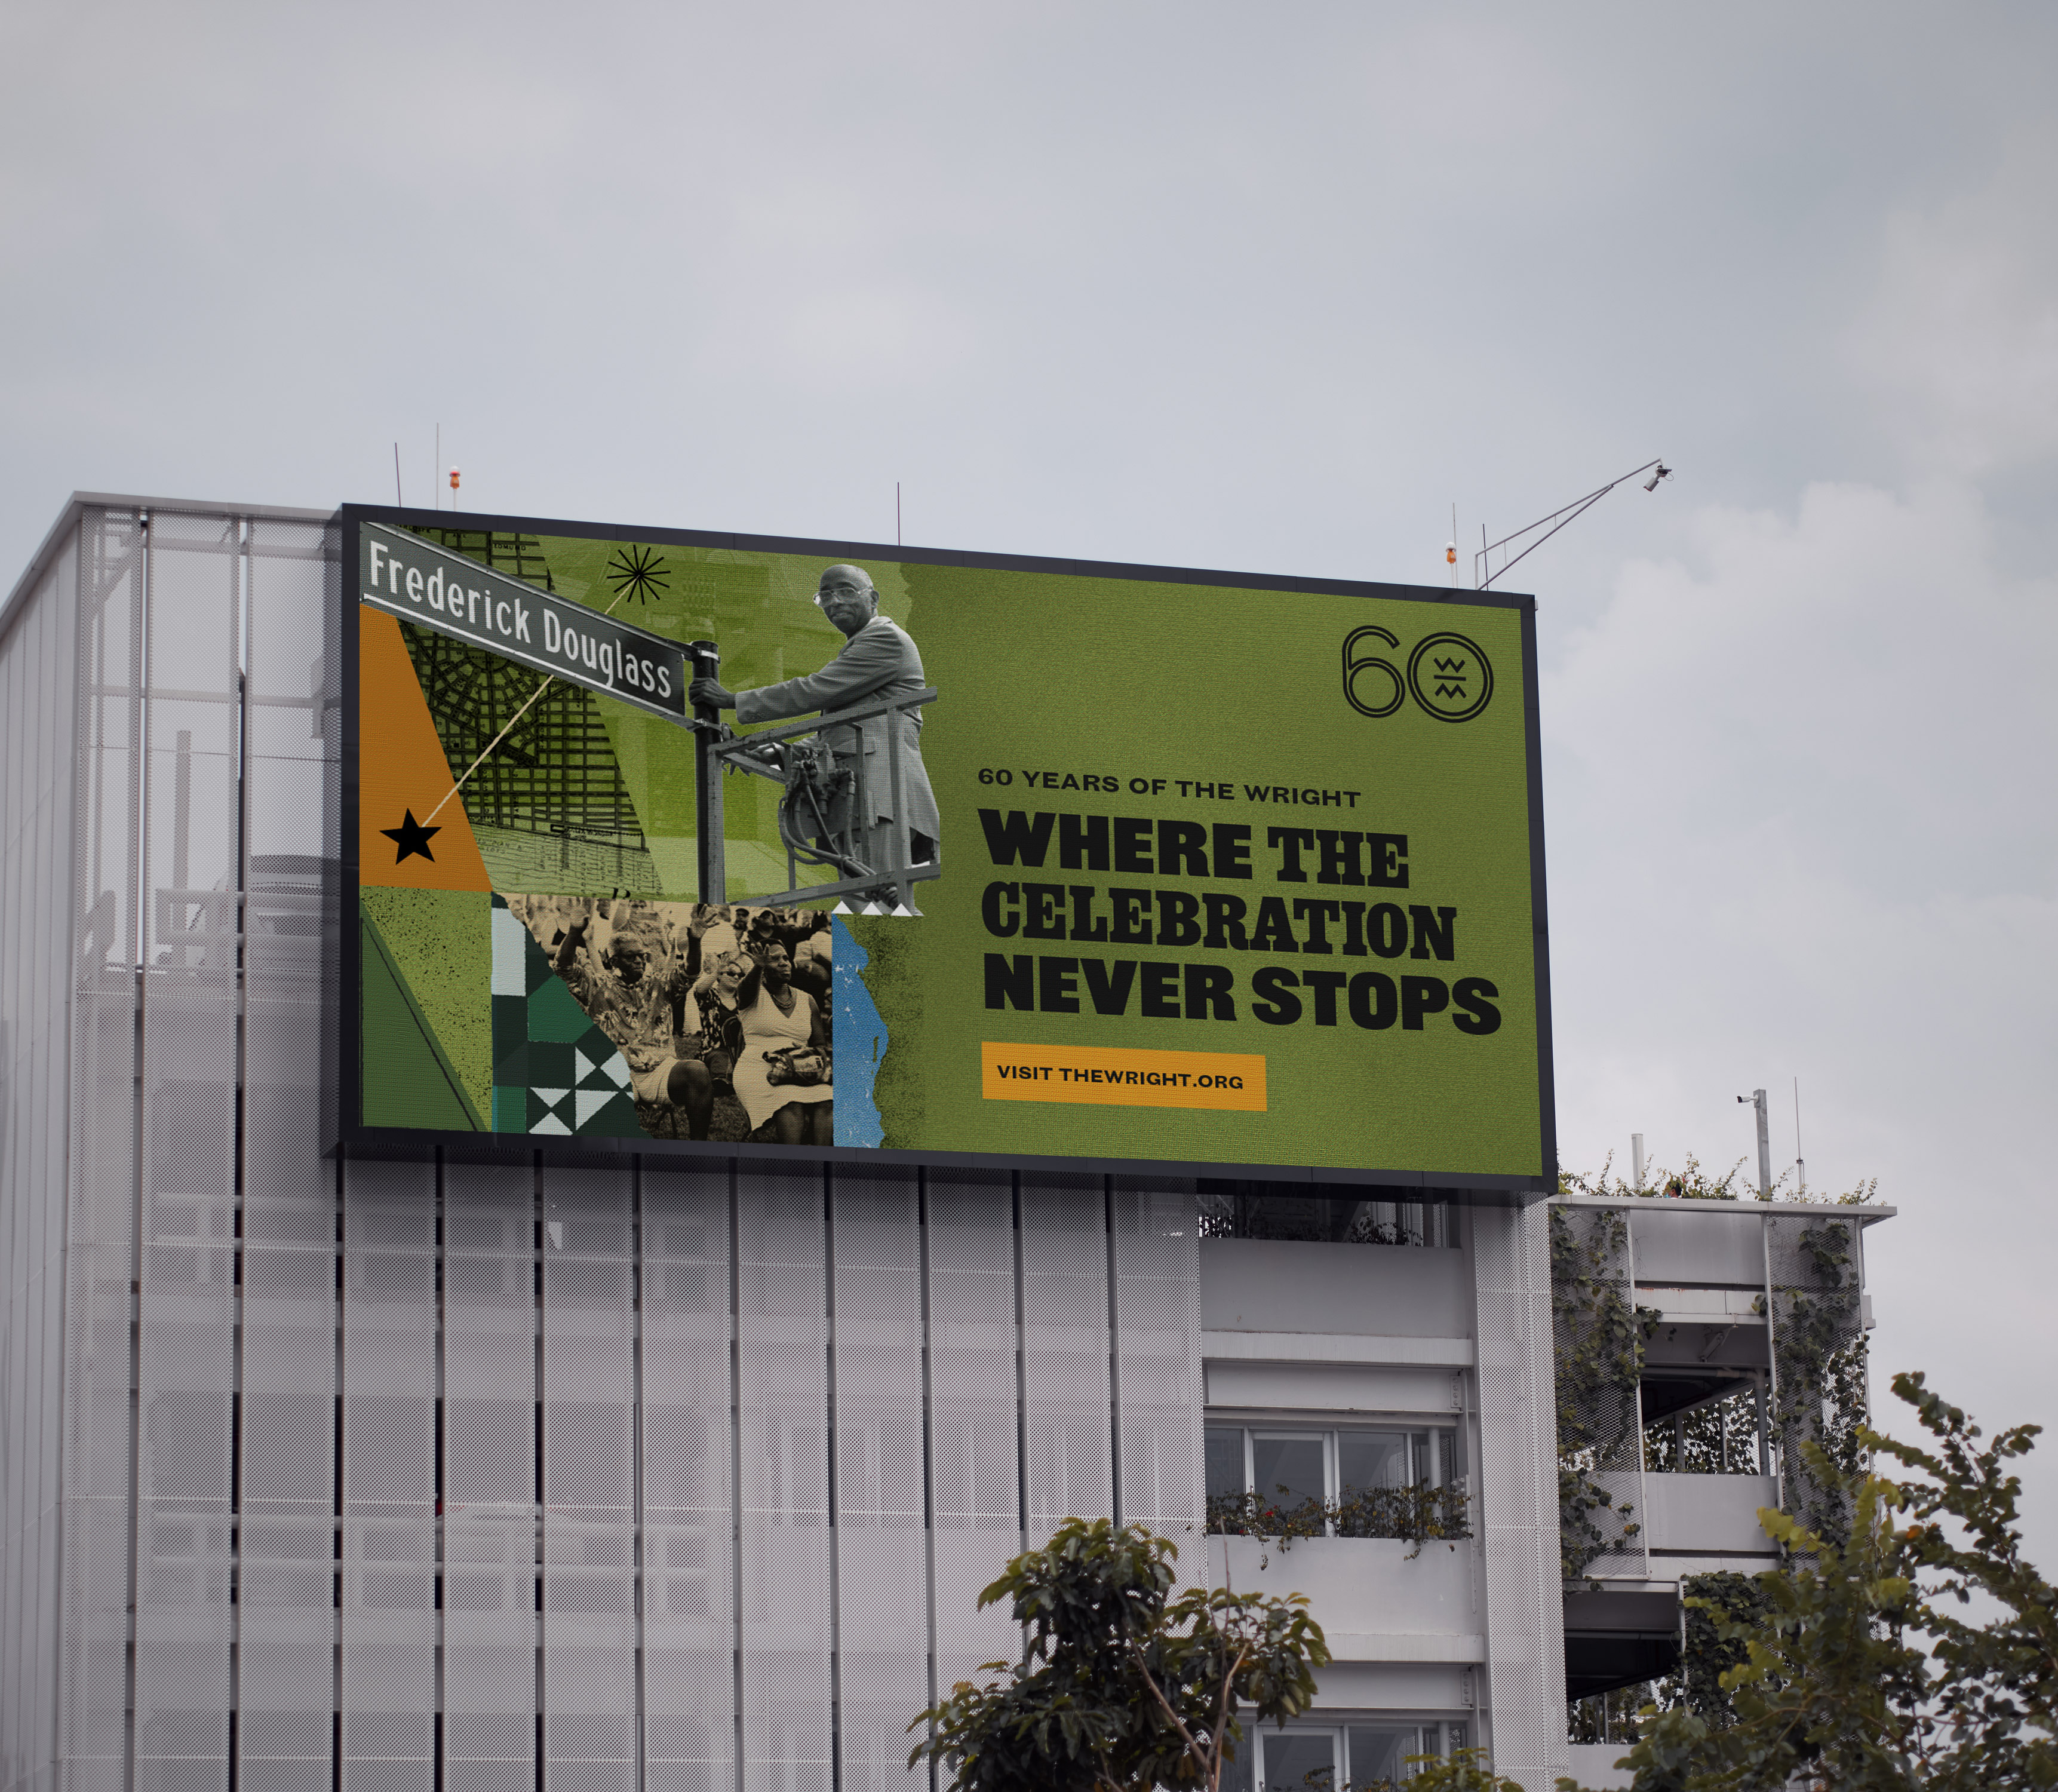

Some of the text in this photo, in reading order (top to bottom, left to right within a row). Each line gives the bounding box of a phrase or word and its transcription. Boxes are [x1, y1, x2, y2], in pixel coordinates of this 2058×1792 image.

[368, 539, 671, 698] Frederick Douglass
[1341, 625, 1494, 723] 60
[978, 768, 1362, 808] 60 YEARS OF THE WRIGHT
[977, 808, 1410, 889] WHERE THE
[981, 880, 1458, 962] CELEBRATION
[984, 952, 1503, 1036] NEVER STOPS
[997, 1065, 1243, 1090] VISIT THEWRIGHT.ORG
